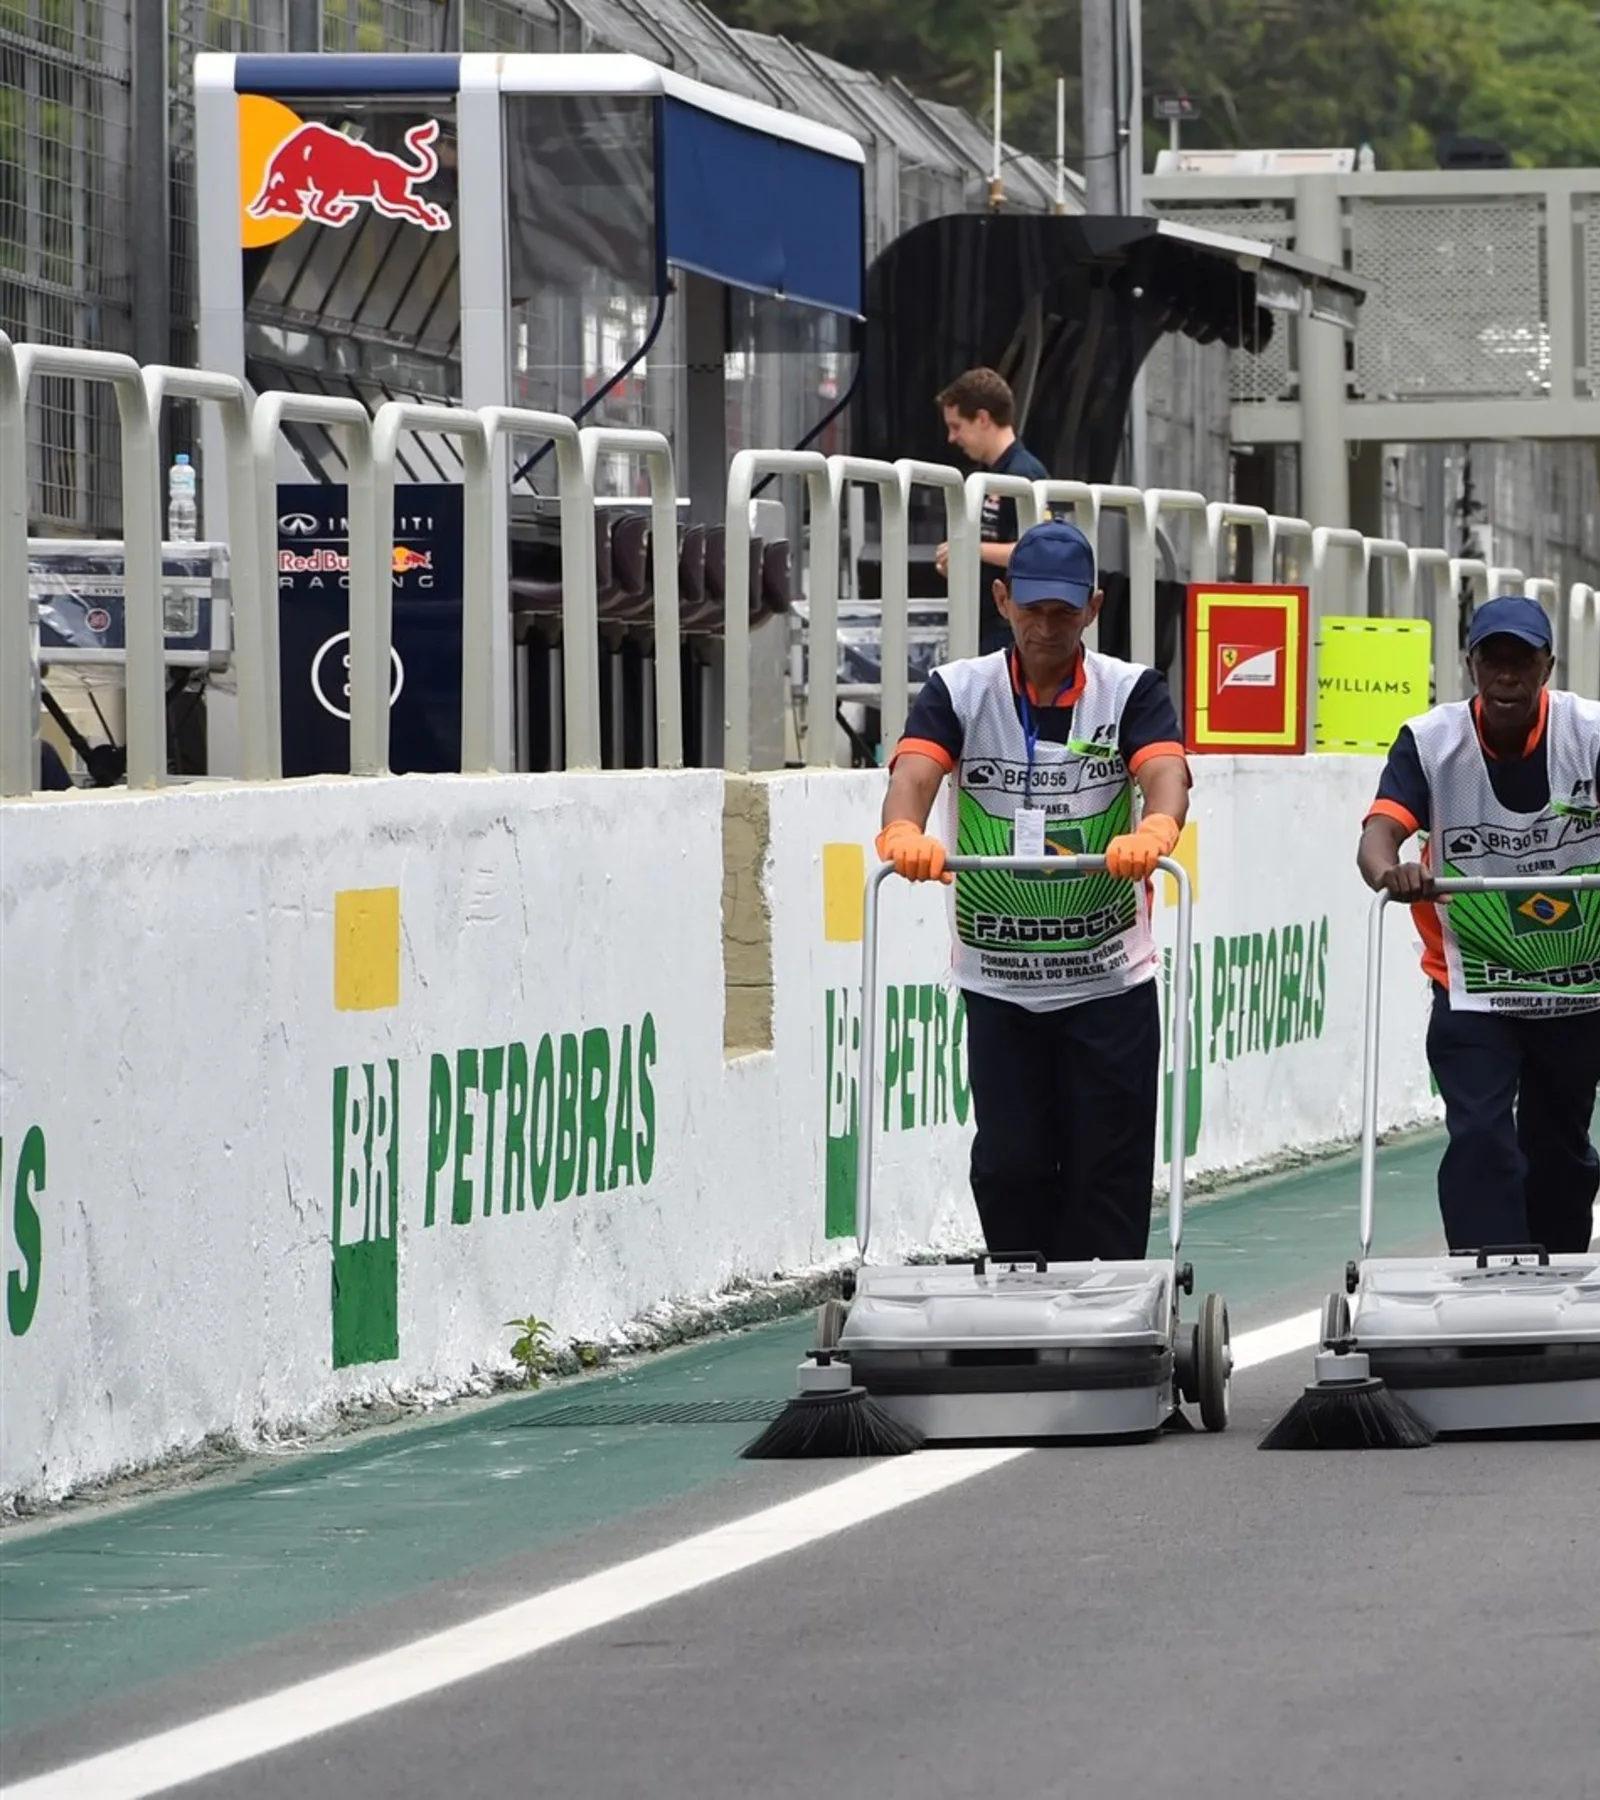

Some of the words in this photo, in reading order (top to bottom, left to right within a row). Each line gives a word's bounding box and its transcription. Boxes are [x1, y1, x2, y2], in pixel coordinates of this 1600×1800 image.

[329, 516, 433, 531] INITI
[279, 549, 322, 573] Red
[279, 576, 434, 589] RACNG
[1318, 677, 1412, 695] WILLIAMS
[1086, 757, 1125, 780] 2015
[1516, 859, 1557, 873] CLEANER
[975, 901, 1121, 942] PADDOCK
[981, 953, 1029, 969] FORMULA
[1034, 958, 1039, 968] 1
[1043, 954, 1090, 968] GRANDE
[981, 966, 1043, 981] PETROBRAS
[1046, 968, 1063, 980] DO
[1065, 962, 1106, 978] BRASIL
[1109, 952, 1130, 970] 2015
[1210, 914, 1328, 1063] PETROBRAS
[883, 983, 972, 1132] PETRO
[424, 1011, 656, 1228] PETROBRAS
